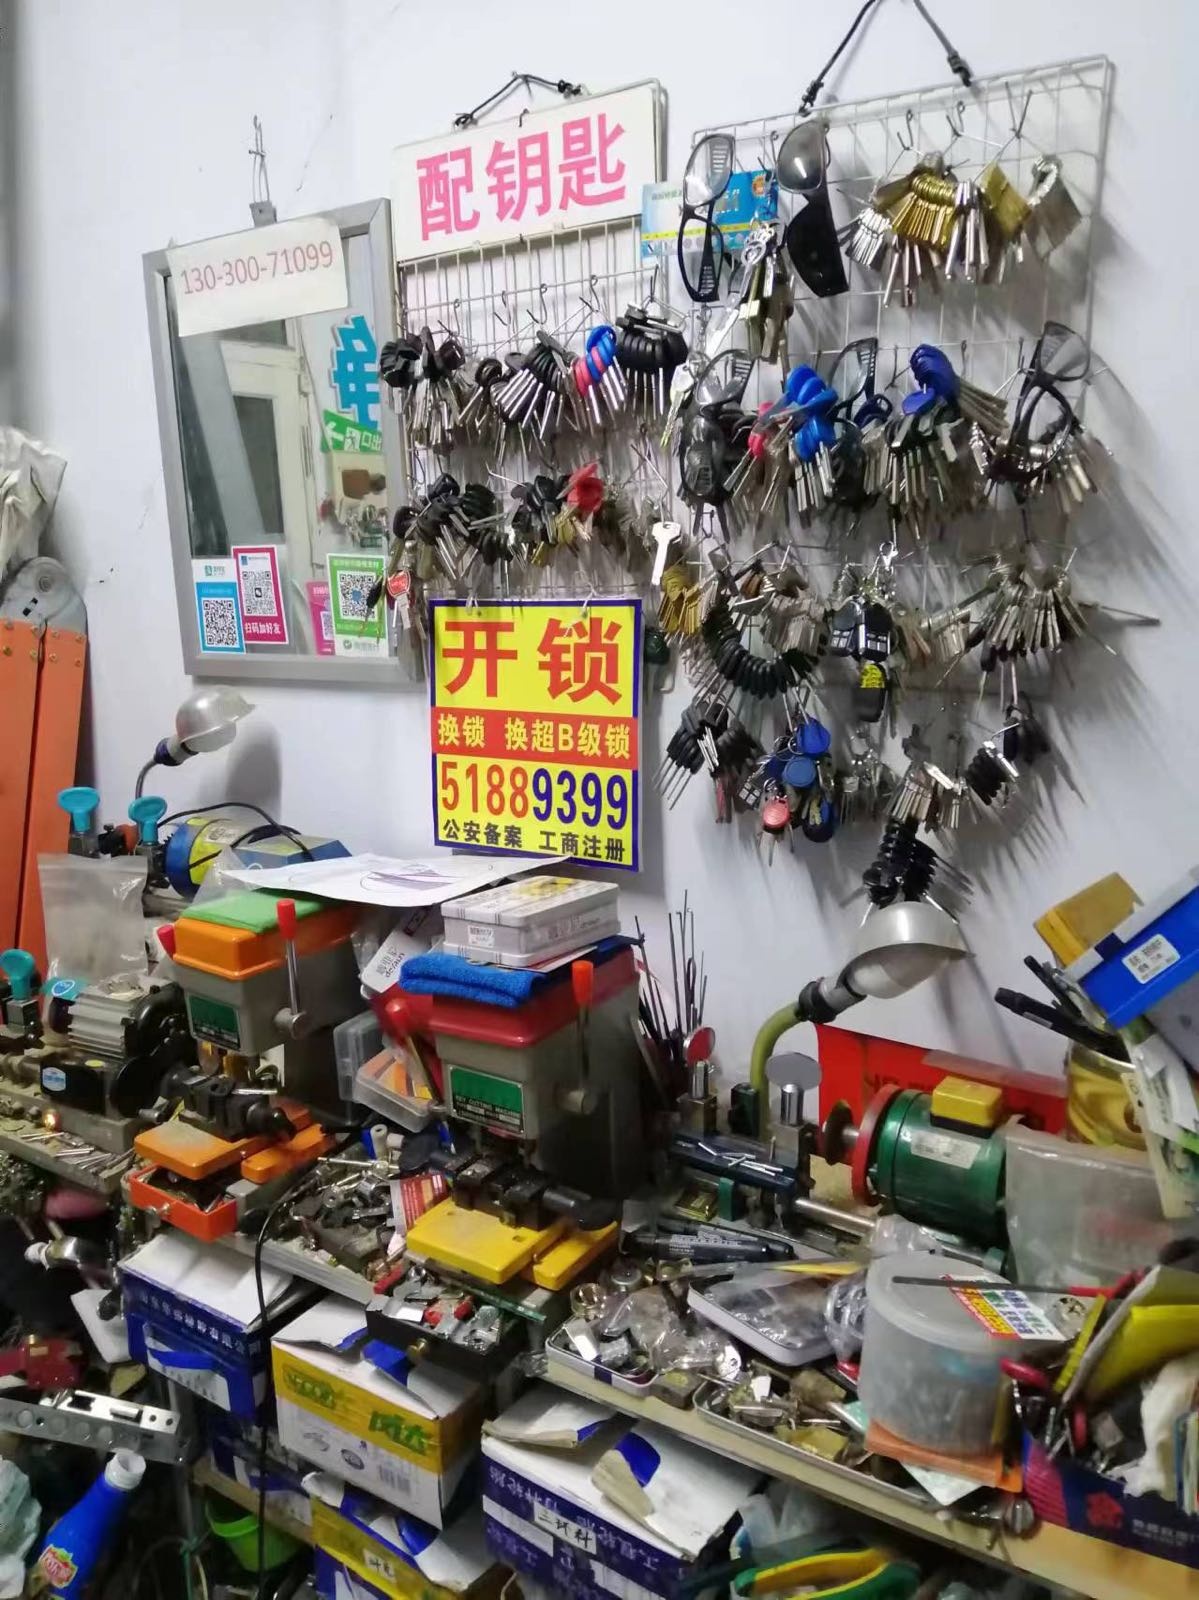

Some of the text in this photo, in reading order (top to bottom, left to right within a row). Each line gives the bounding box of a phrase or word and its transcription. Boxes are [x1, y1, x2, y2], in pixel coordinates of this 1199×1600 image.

[416, 113, 626, 240] 配钥匙
[180, 241, 333, 294] 130-300-71099
[442, 616, 623, 705] 开锁
[438, 713, 630, 759] 换锁 换超B级锁
[441, 761, 628, 830] 51889399
[443, 818, 625, 862] 公安备案 工商注册
